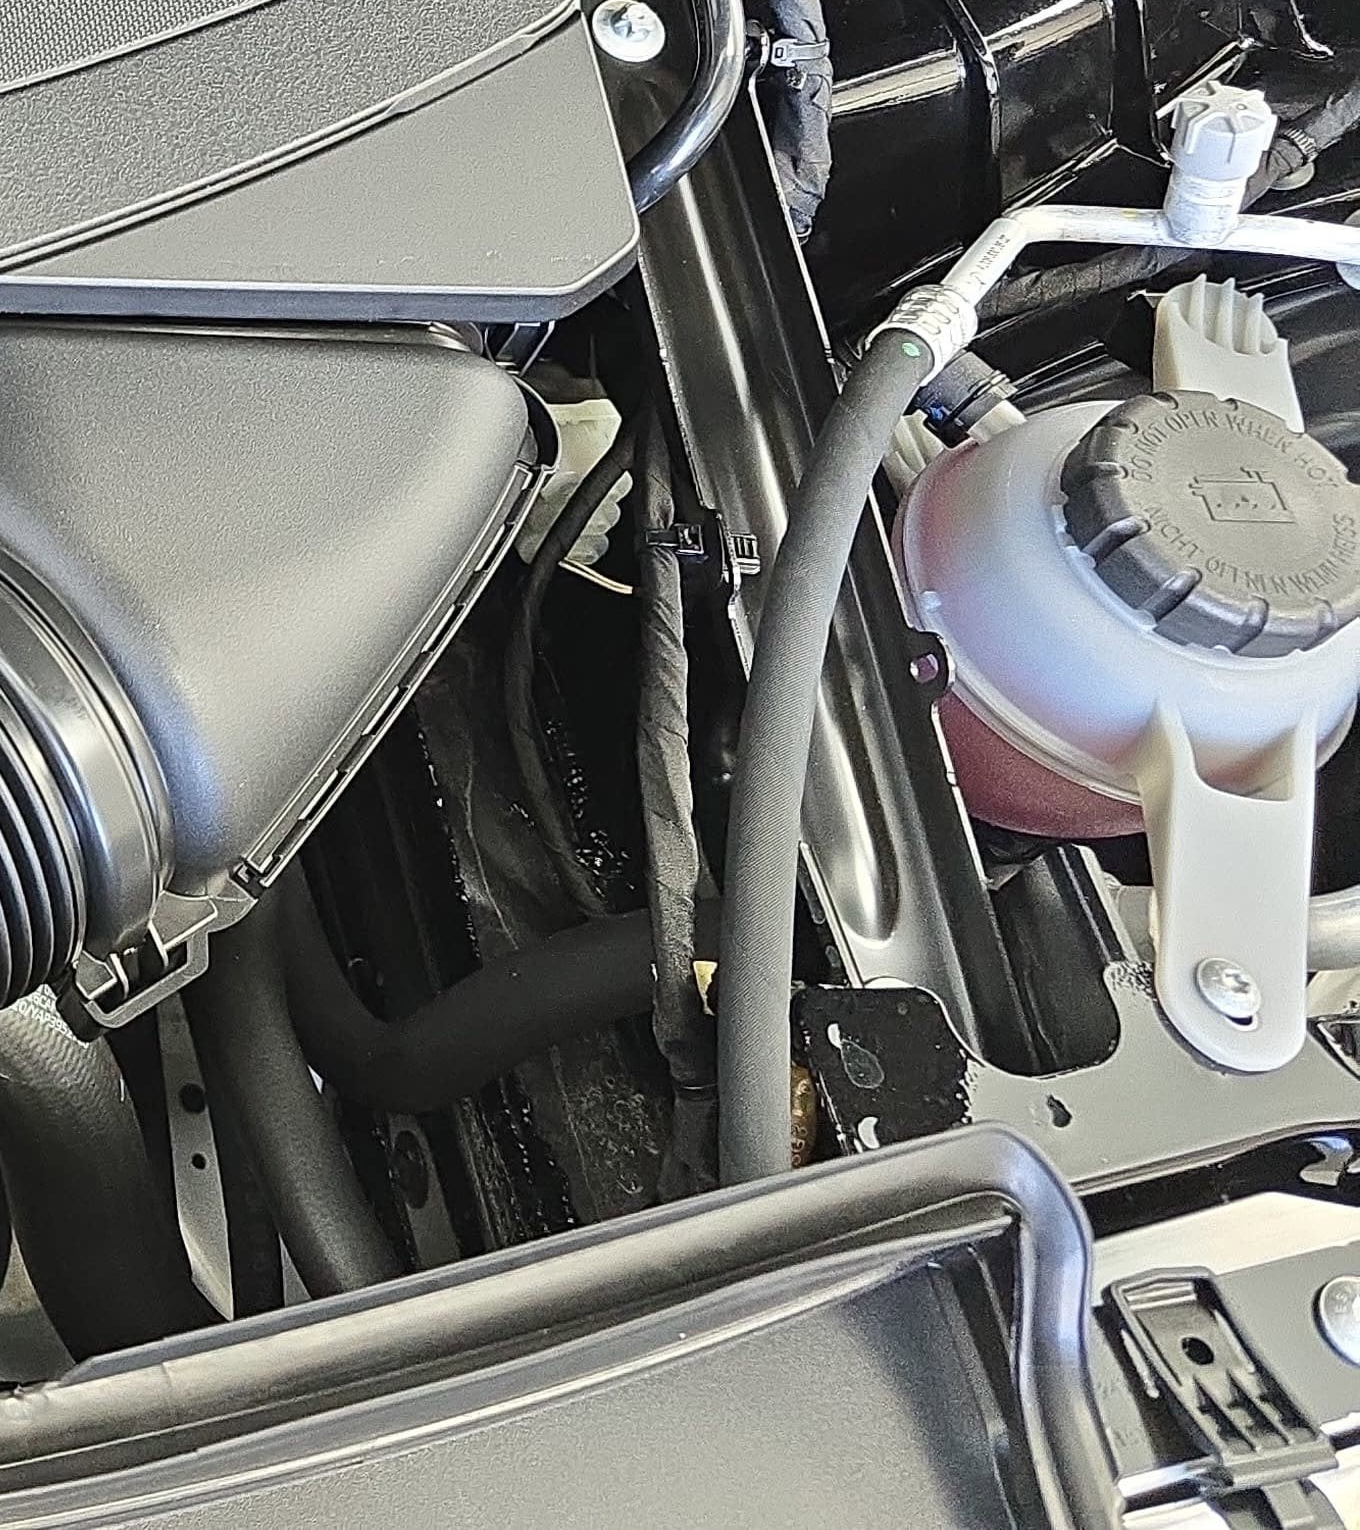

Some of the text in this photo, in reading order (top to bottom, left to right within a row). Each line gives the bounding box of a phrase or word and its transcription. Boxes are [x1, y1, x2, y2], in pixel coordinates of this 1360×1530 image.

[1135, 421, 1168, 456] NOT
[1164, 410, 1219, 432] OPEN
[1225, 413, 1293, 454] WHEN
[1293, 452, 1340, 488] HOT
[1142, 506, 1200, 559] NICHT
